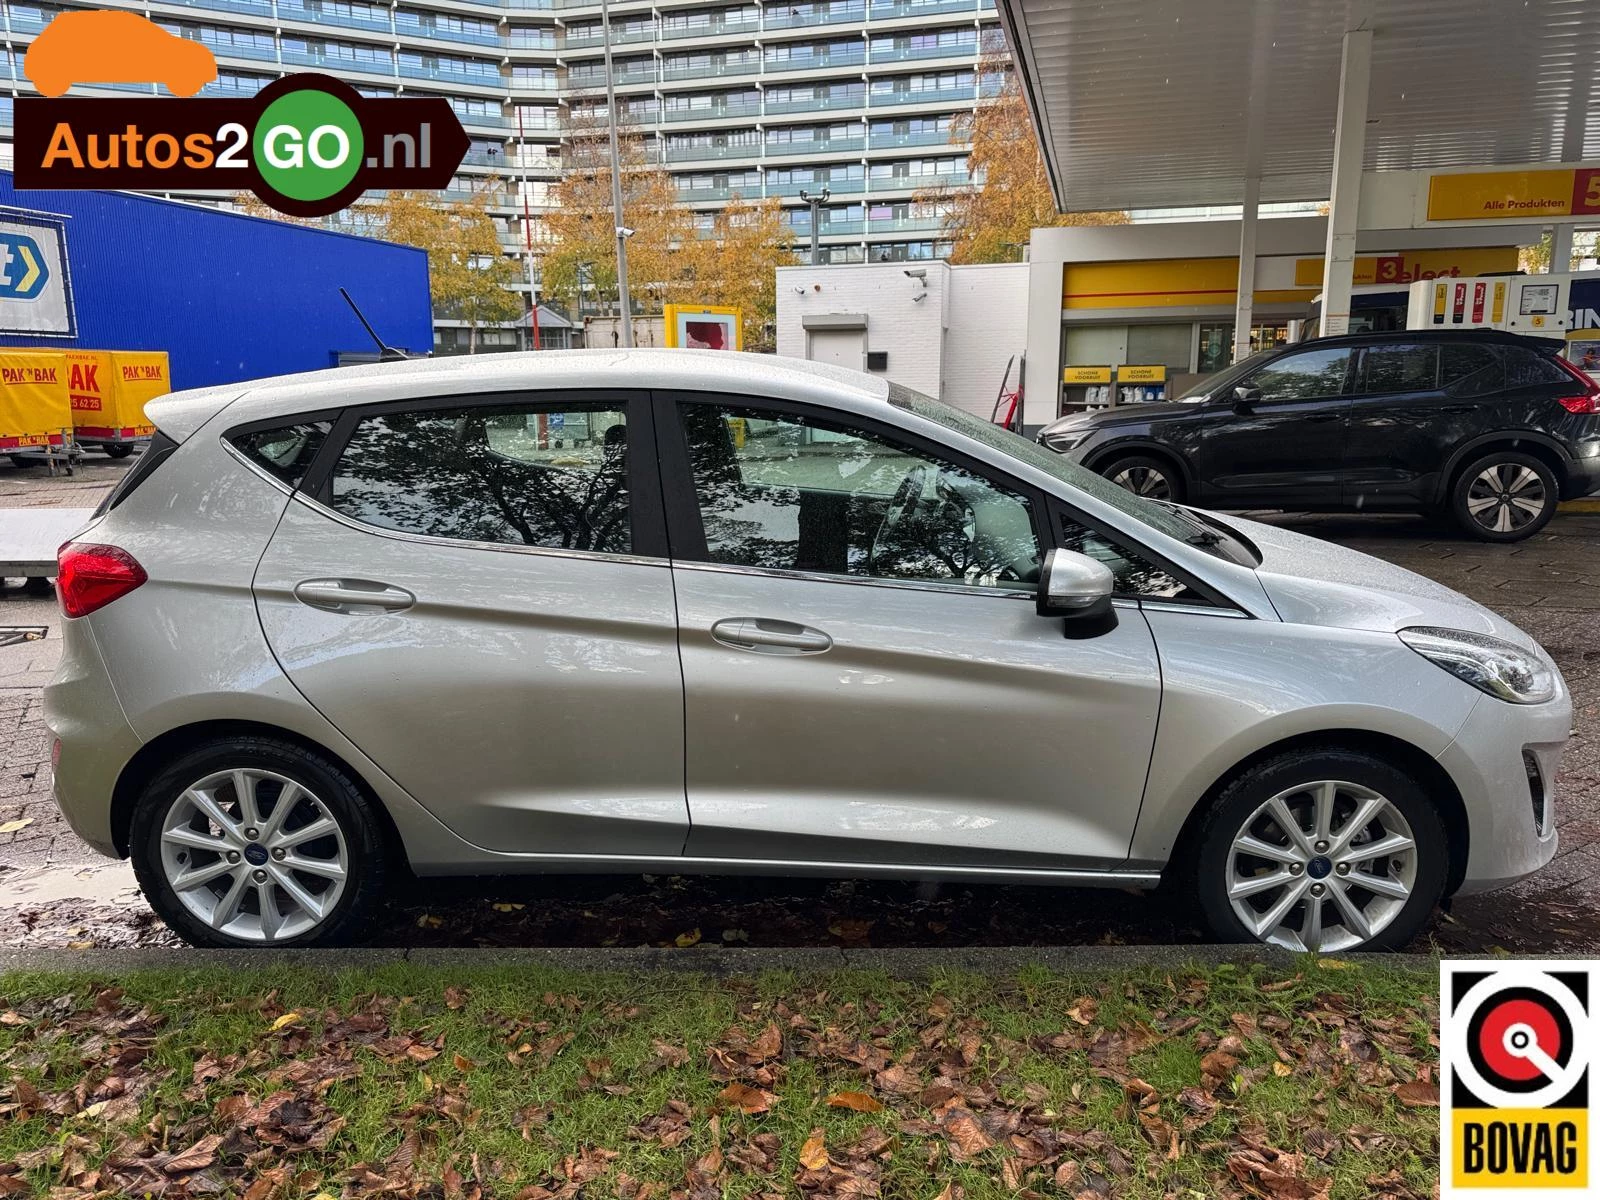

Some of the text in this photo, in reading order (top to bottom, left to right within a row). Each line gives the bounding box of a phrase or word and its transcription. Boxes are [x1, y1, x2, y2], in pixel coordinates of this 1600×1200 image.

[1584, 176, 1600, 207] 5
[1483, 199, 1566, 210] Alle Produkten
[1382, 260, 1397, 280] 3
[1401, 262, 1462, 284] elect
[1, 368, 26, 382] PAK
[34, 367, 57, 382] BAK
[66, 363, 101, 393] AK
[122, 366, 140, 379] PAK
[145, 365, 162, 378] BAK
[79, 398, 89, 408] 62
[90, 399, 100, 409] 25
[18, 436, 31, 447] PAK
[36, 435, 50, 445] BAK
